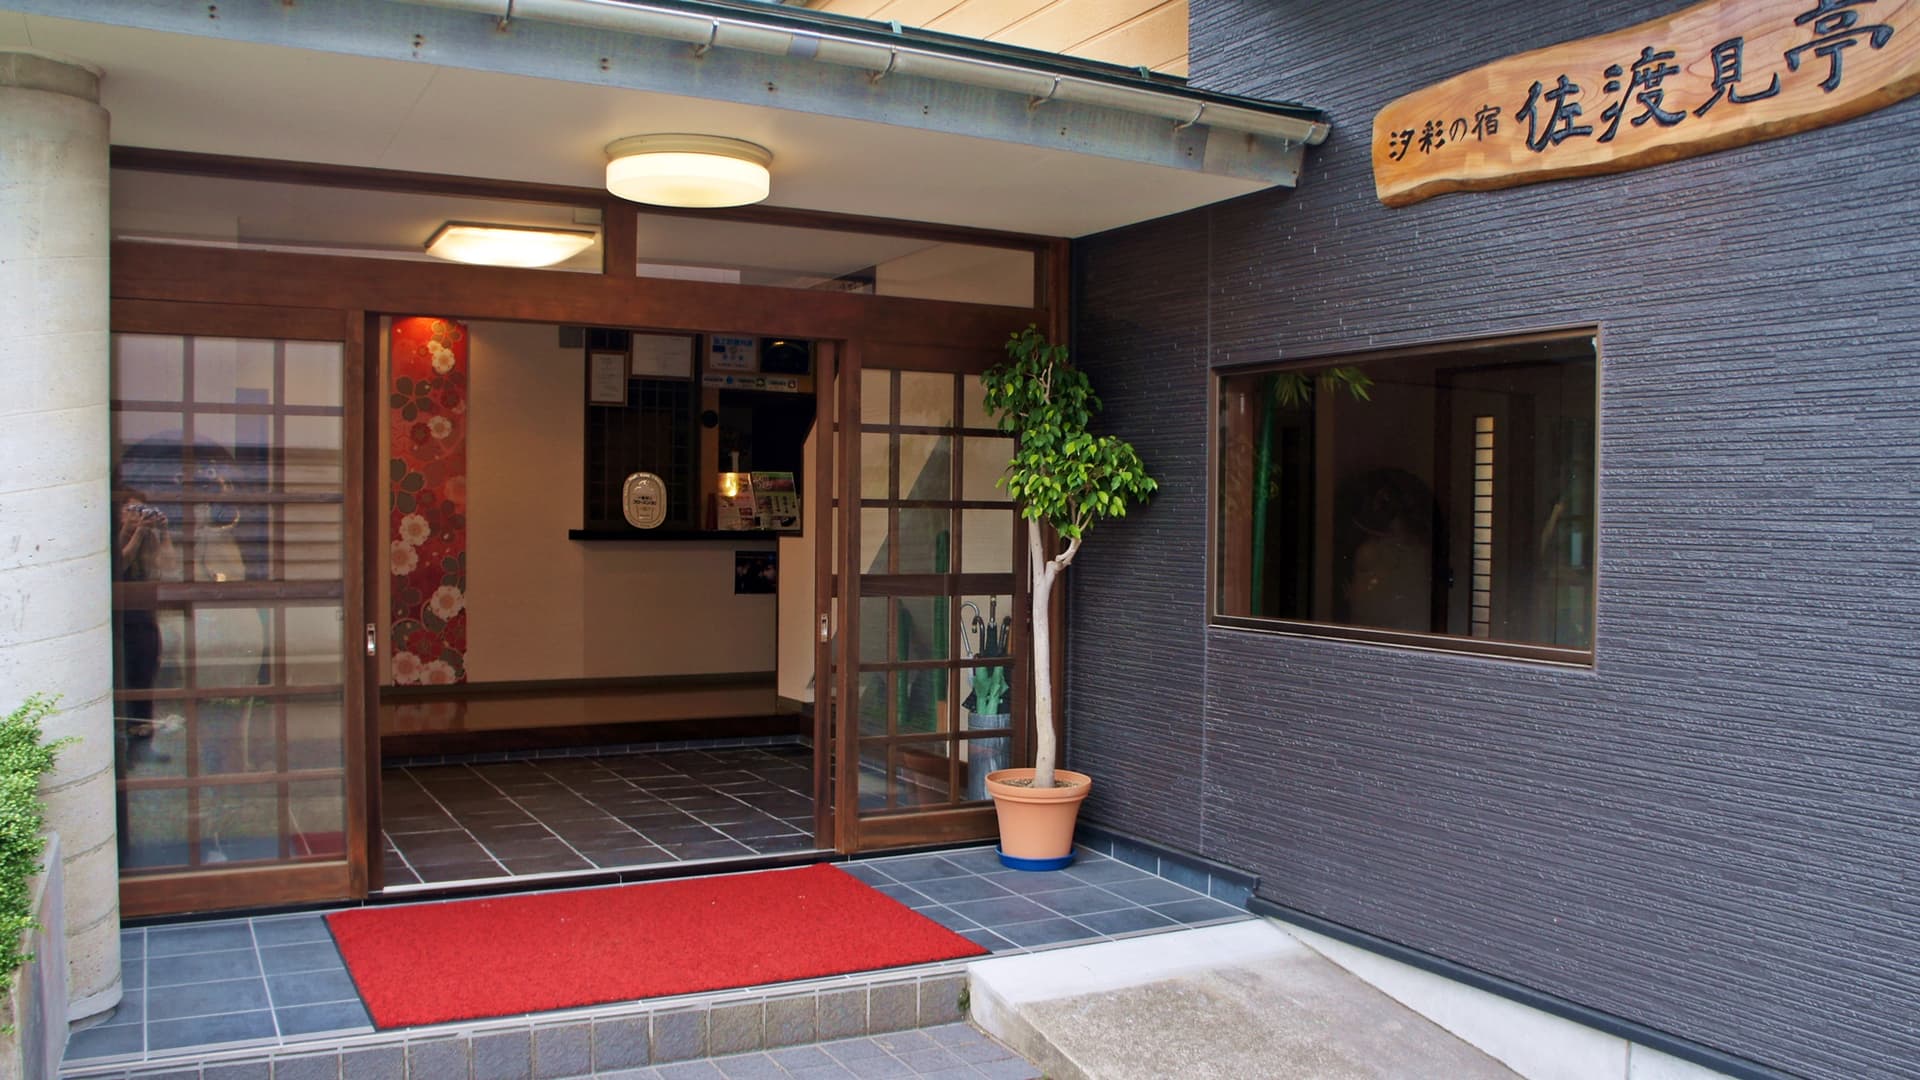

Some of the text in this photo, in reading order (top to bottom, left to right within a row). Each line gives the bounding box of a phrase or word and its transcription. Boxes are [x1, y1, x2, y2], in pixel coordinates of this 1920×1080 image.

[1388, 0, 1895, 161] 汐彩の宿 佐渡見亭
